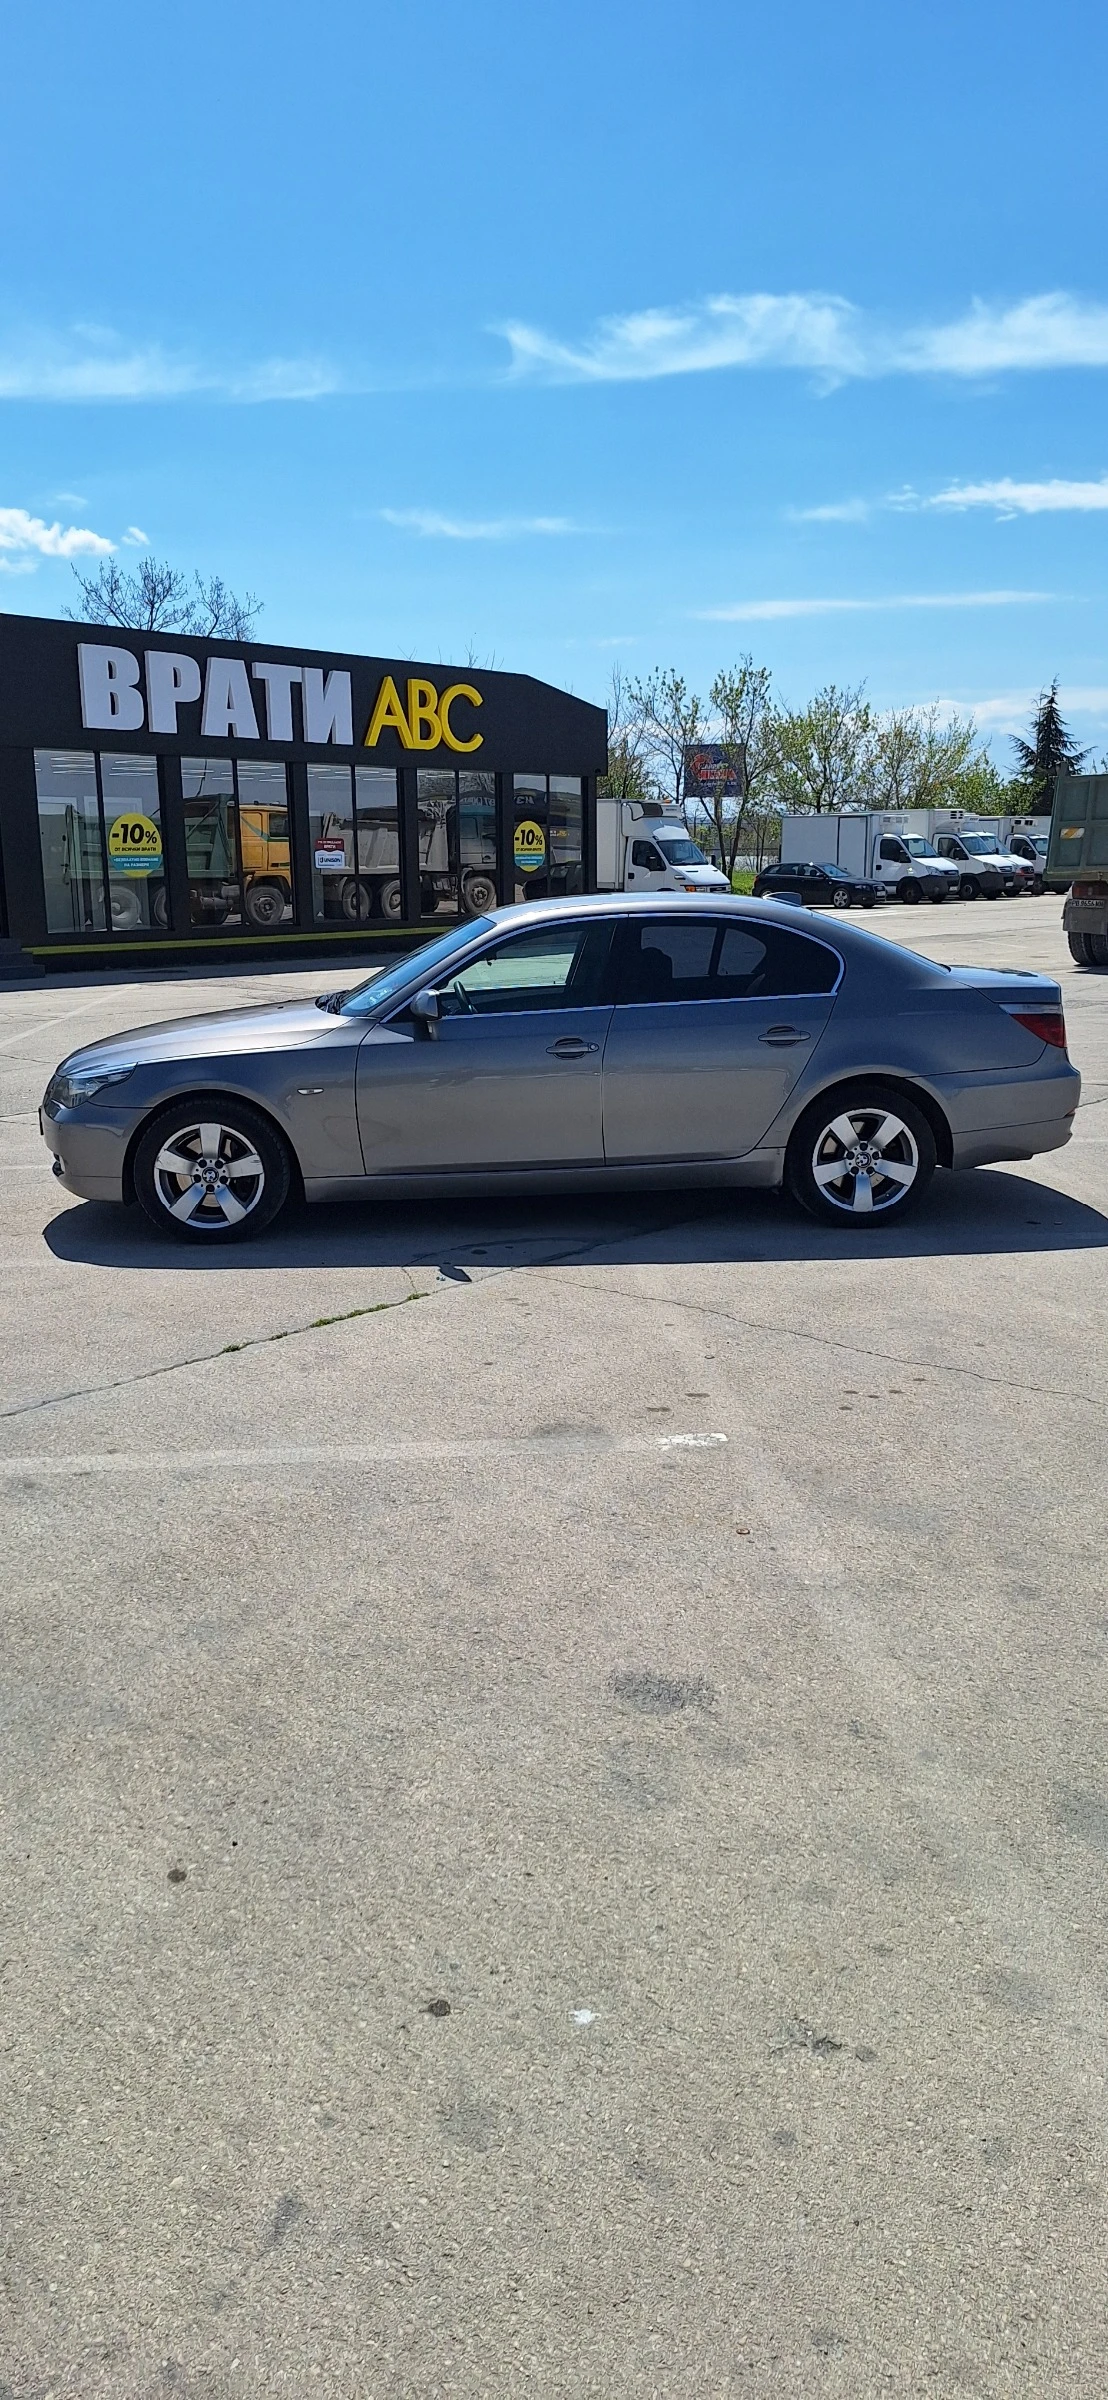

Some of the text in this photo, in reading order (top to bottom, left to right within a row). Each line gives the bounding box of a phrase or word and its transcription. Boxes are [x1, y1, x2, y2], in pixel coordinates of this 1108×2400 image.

[77, 643, 484, 752] ВРАТИ ABC
[112, 823, 158, 844] -10%
[514, 829, 543, 846] -10%
